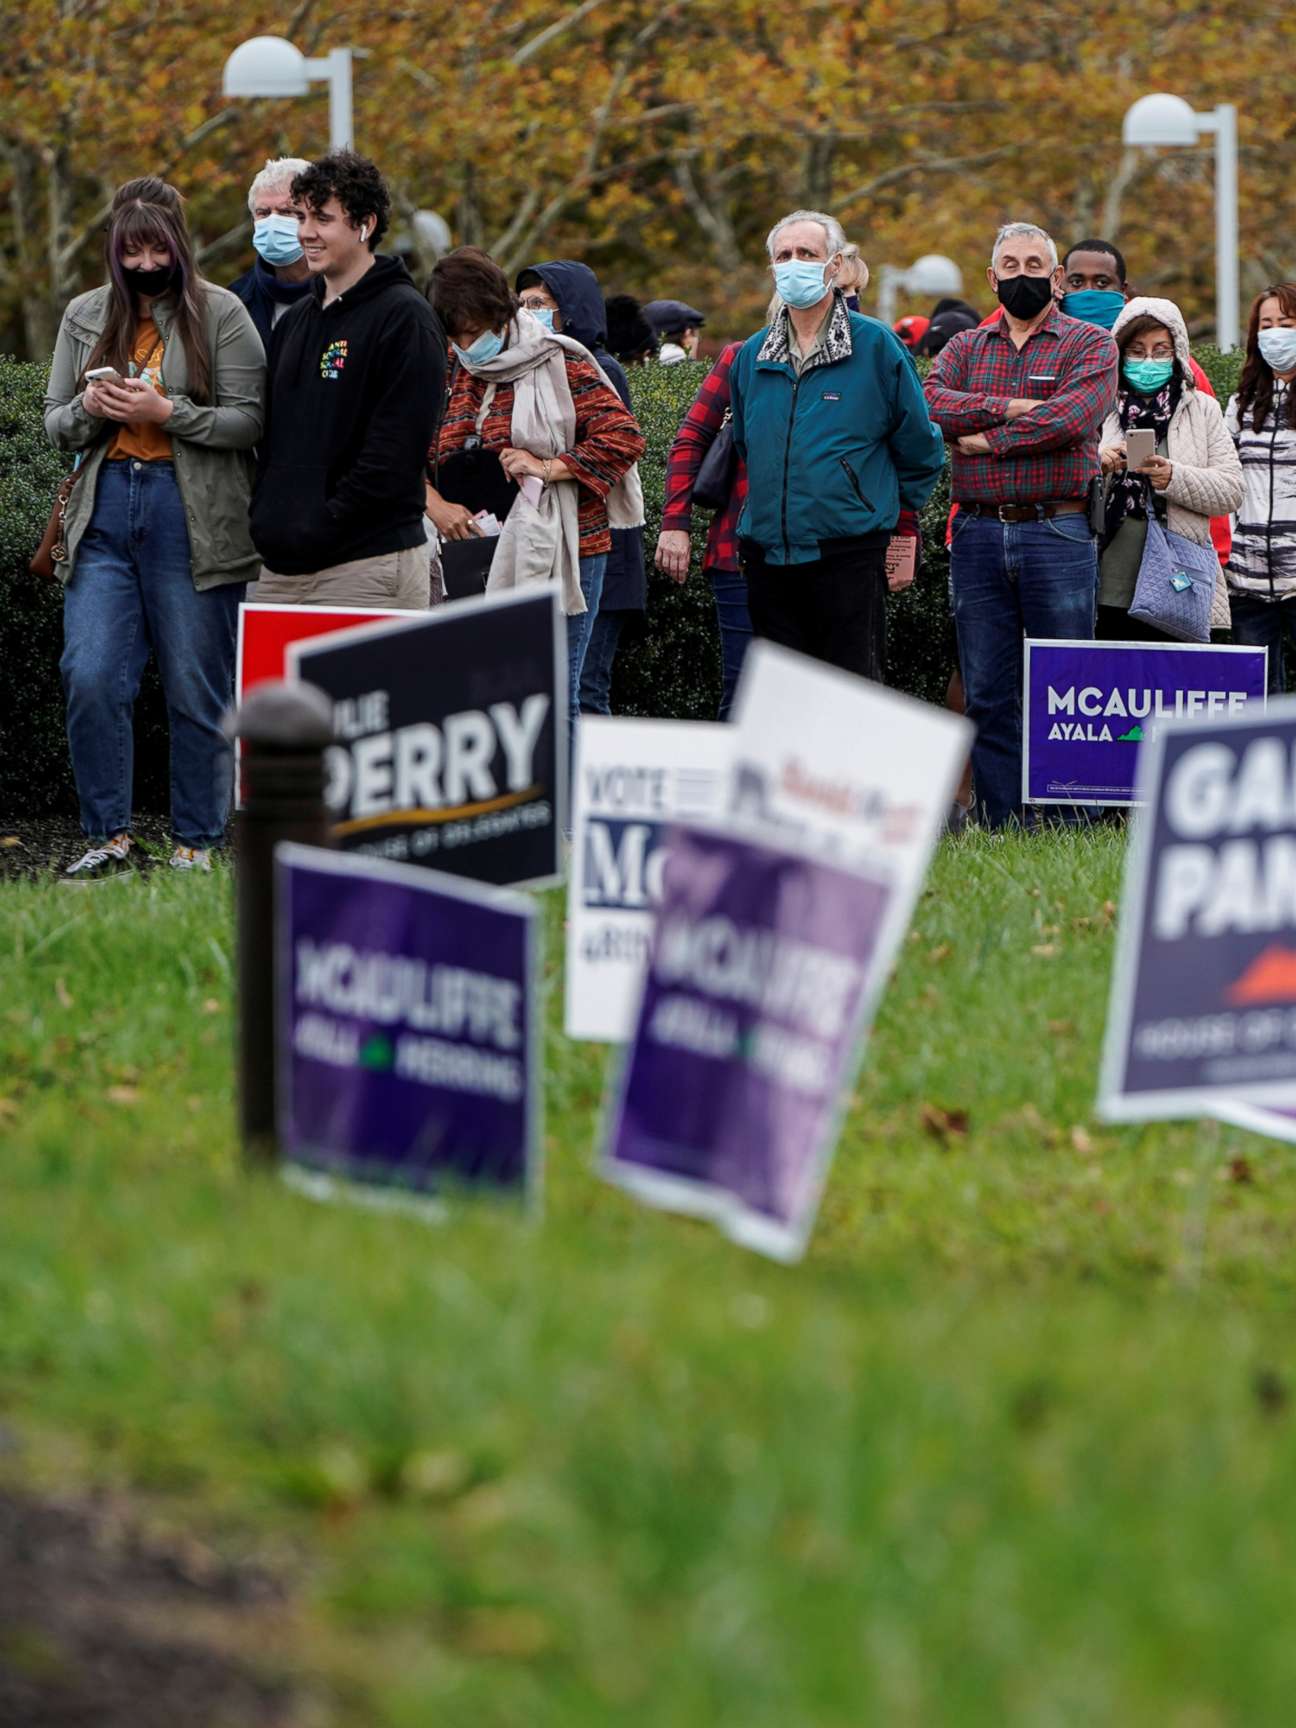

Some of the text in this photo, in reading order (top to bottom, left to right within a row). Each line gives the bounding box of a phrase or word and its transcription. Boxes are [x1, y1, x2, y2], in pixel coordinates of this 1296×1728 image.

[1047, 686, 1248, 719] MCAULIFFE
[1048, 723, 1113, 742] AYALA
[585, 764, 668, 812] VOTE
[1241, 1008, 1284, 1046] OF
